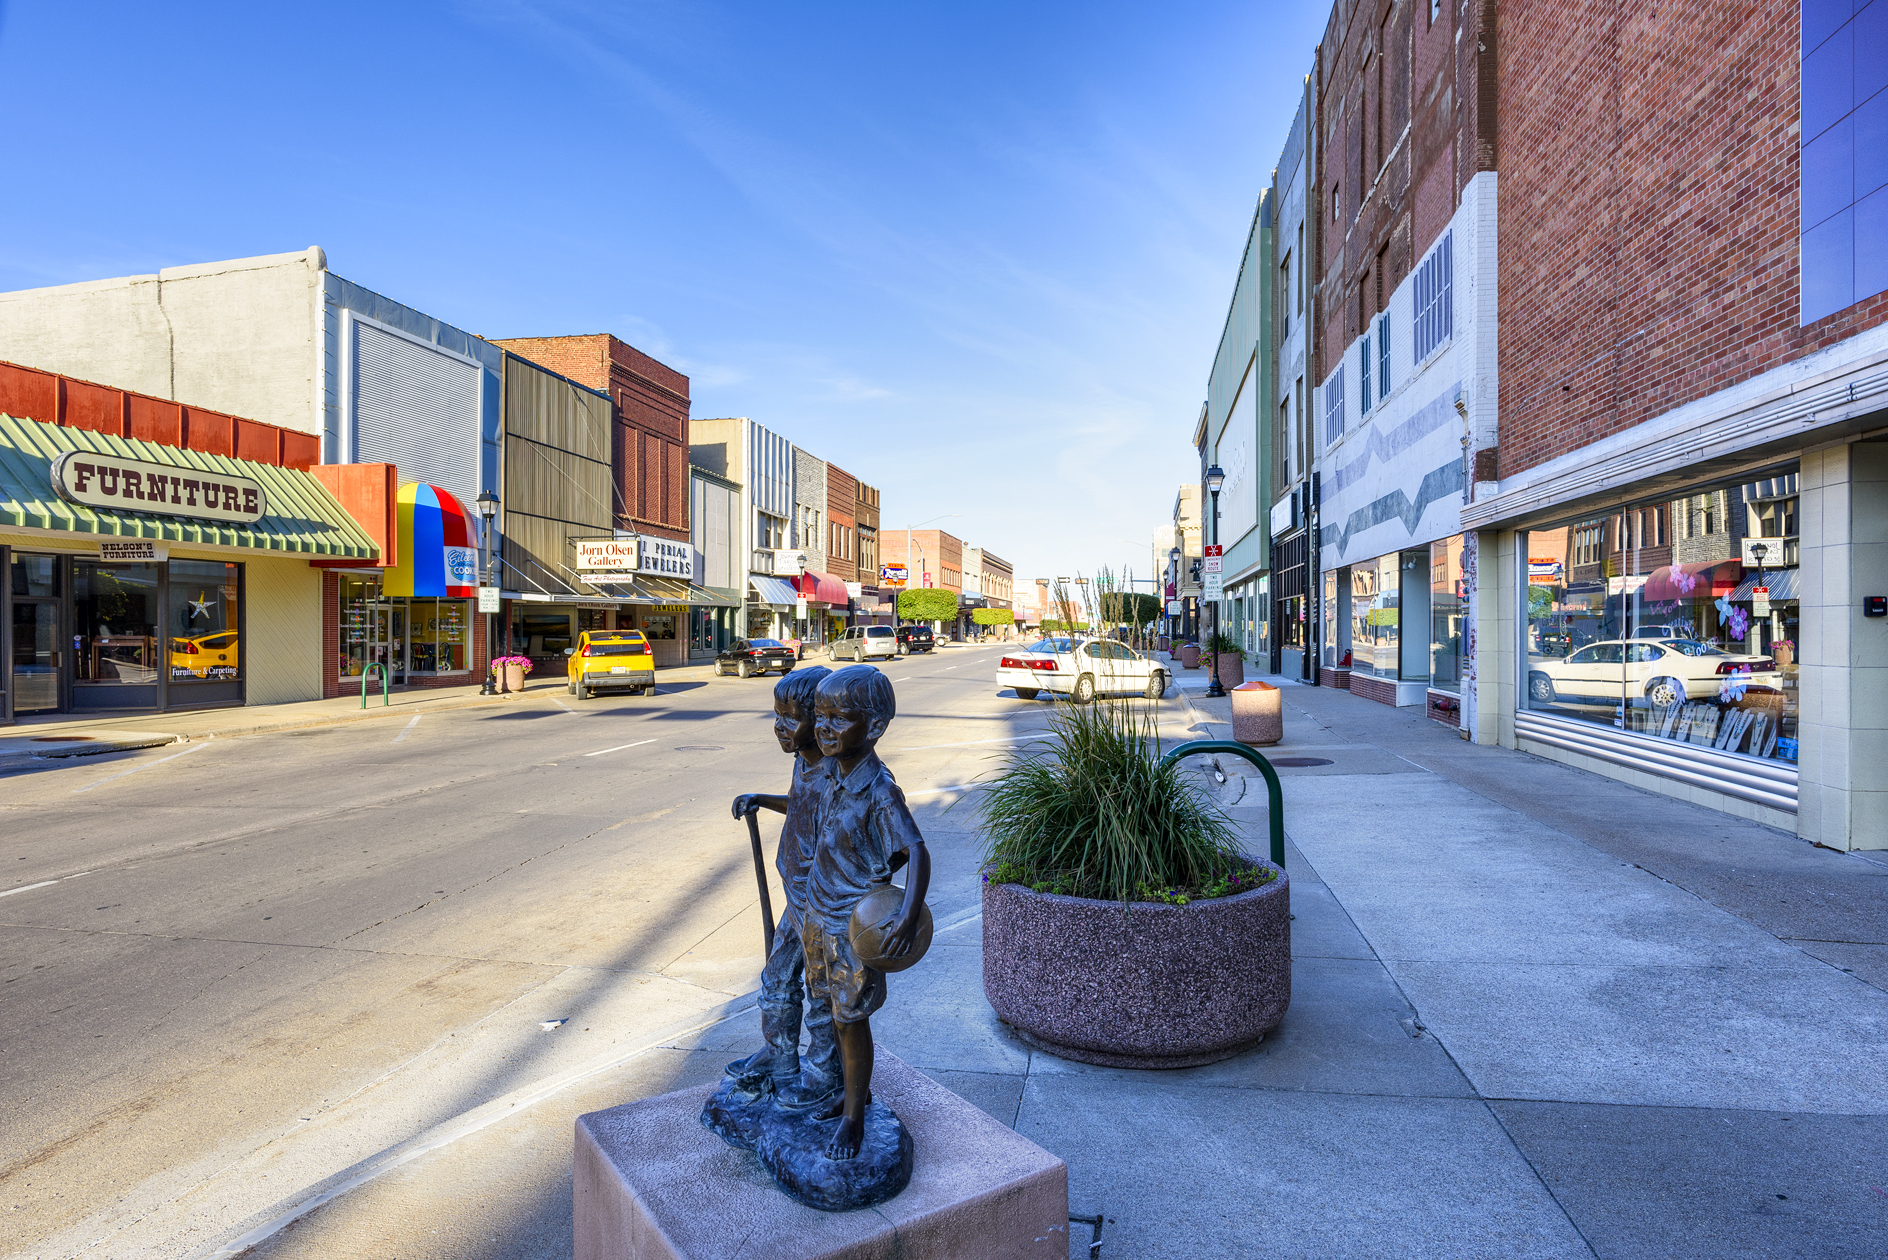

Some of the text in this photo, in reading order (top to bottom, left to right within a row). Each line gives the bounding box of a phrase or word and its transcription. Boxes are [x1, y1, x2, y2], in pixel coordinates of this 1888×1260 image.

[74, 461, 259, 515] FURNITURE
[101, 542, 153, 551] NELSON'S
[579, 543, 634, 556] Jorn Olsen
[103, 551, 155, 559] FURNITURE
[588, 556, 624, 567] Gallery
[603, 575, 631, 583] Photography
[653, 604, 687, 612] JEWELERS
[172, 665, 237, 677] Furniture & Carpeting
